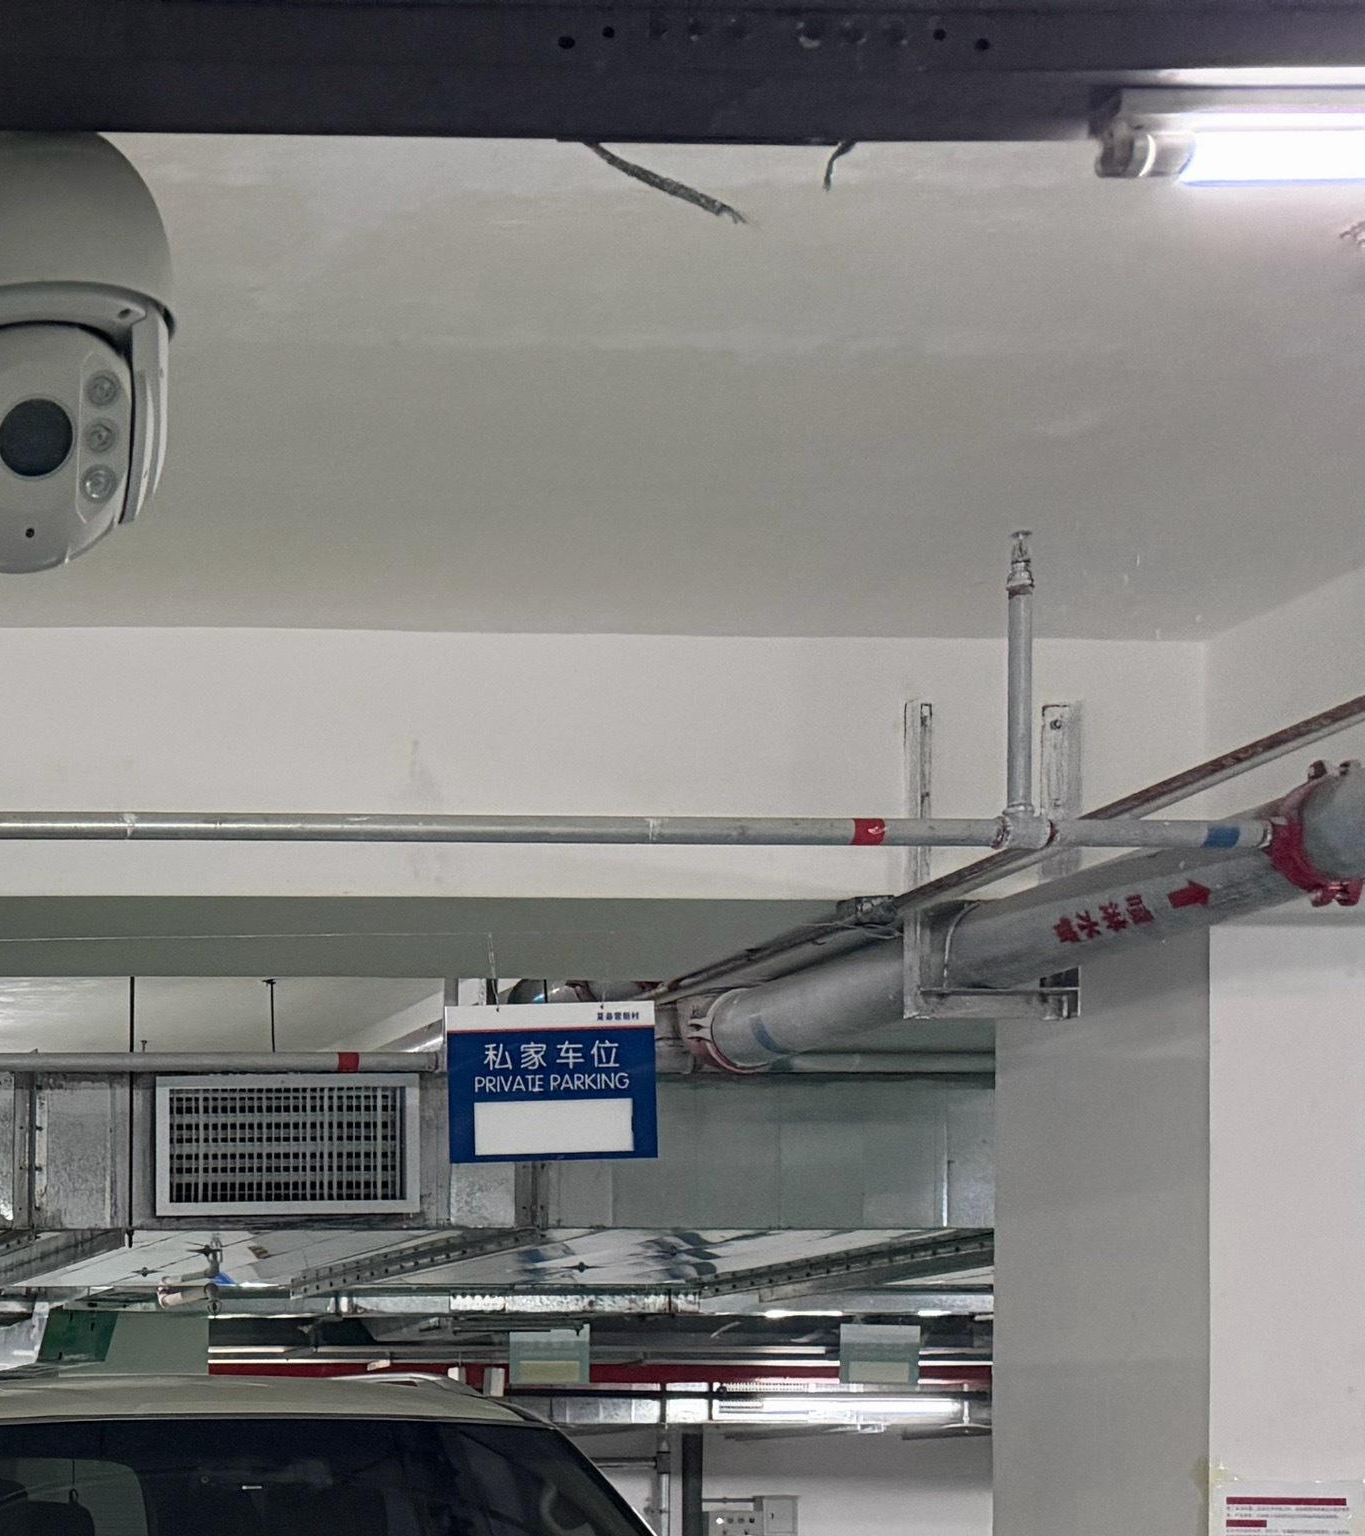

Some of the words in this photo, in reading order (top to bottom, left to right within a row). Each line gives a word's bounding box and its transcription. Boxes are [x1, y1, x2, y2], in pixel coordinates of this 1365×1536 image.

[484, 1040, 620, 1071] 私家车位
[474, 1074, 544, 1093] PRIVATE
[550, 1072, 630, 1091] PARKING
